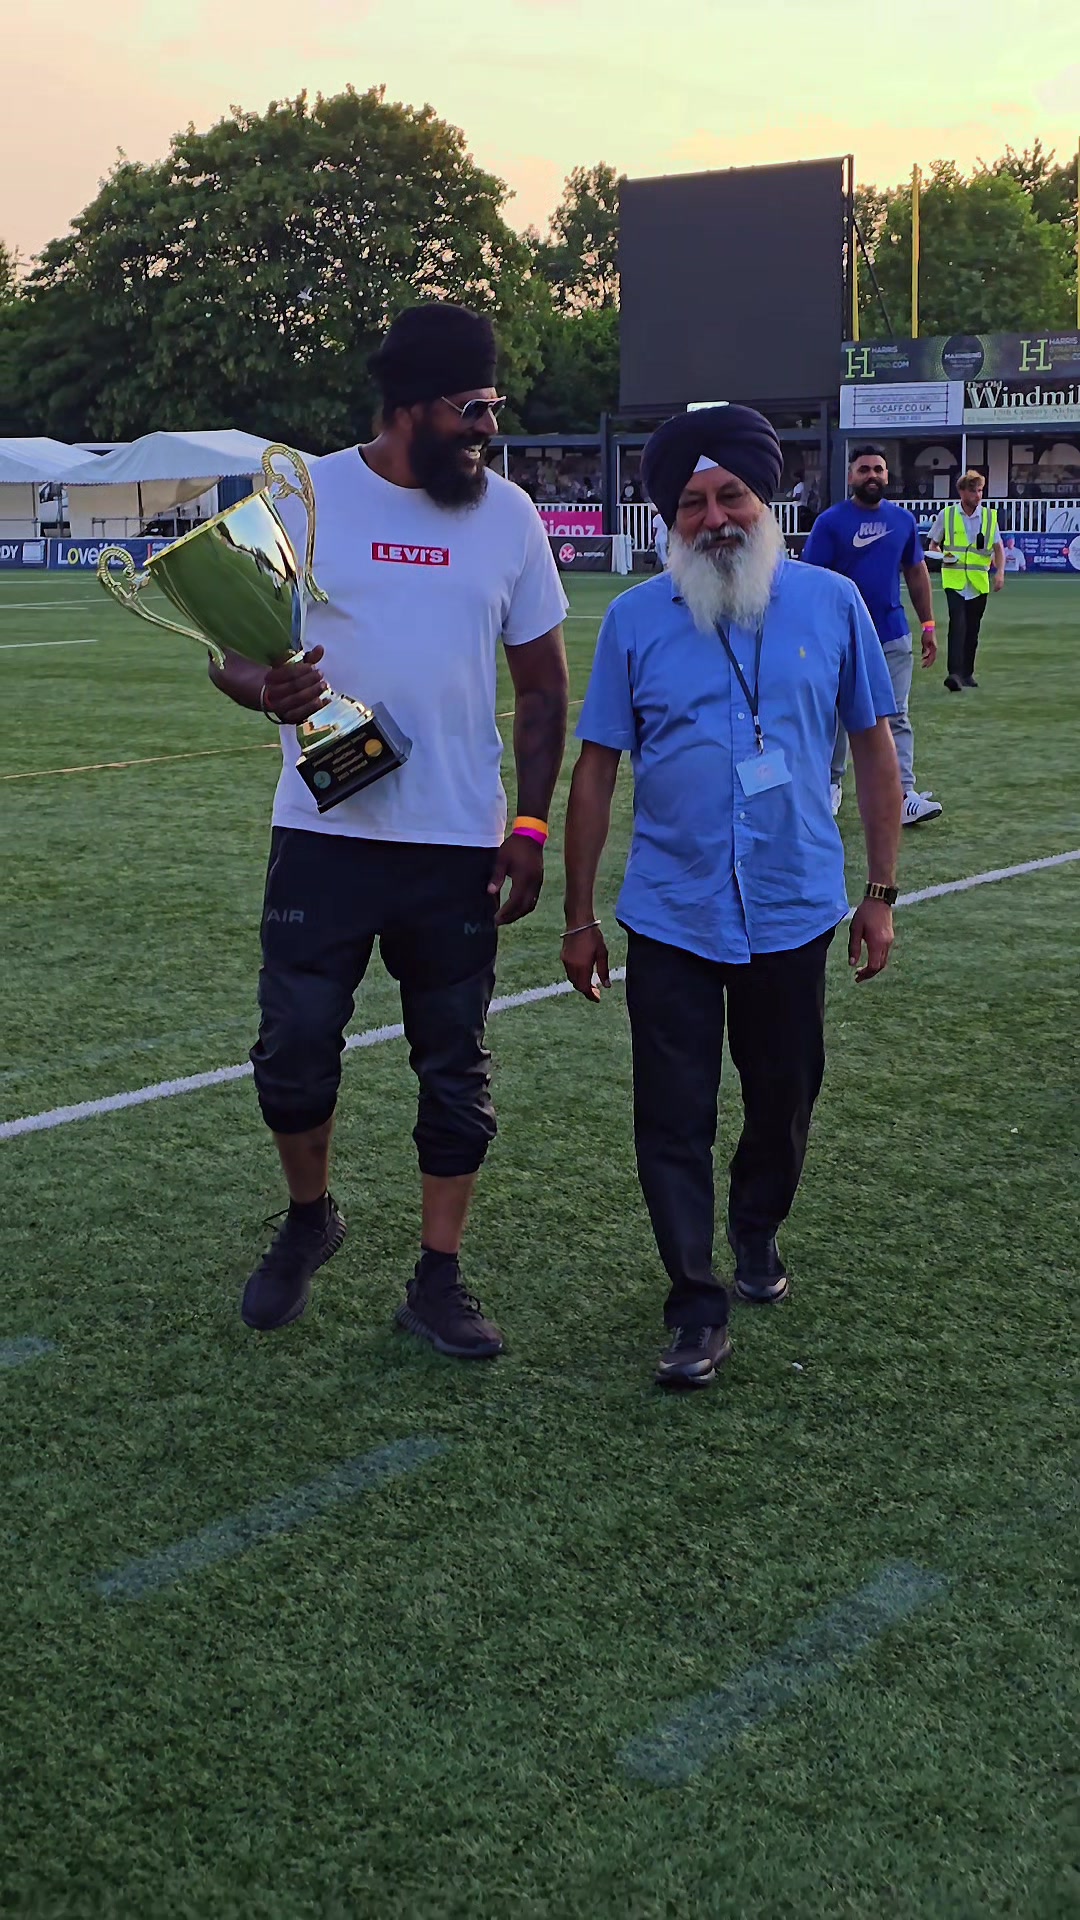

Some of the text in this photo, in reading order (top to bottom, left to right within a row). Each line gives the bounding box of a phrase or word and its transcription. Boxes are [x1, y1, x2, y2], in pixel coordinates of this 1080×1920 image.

[860, 522, 887, 536] RUN
[0, 545, 19, 559] DY
[377, 545, 444, 563] LEVI'S
[266, 908, 305, 923] AIR
